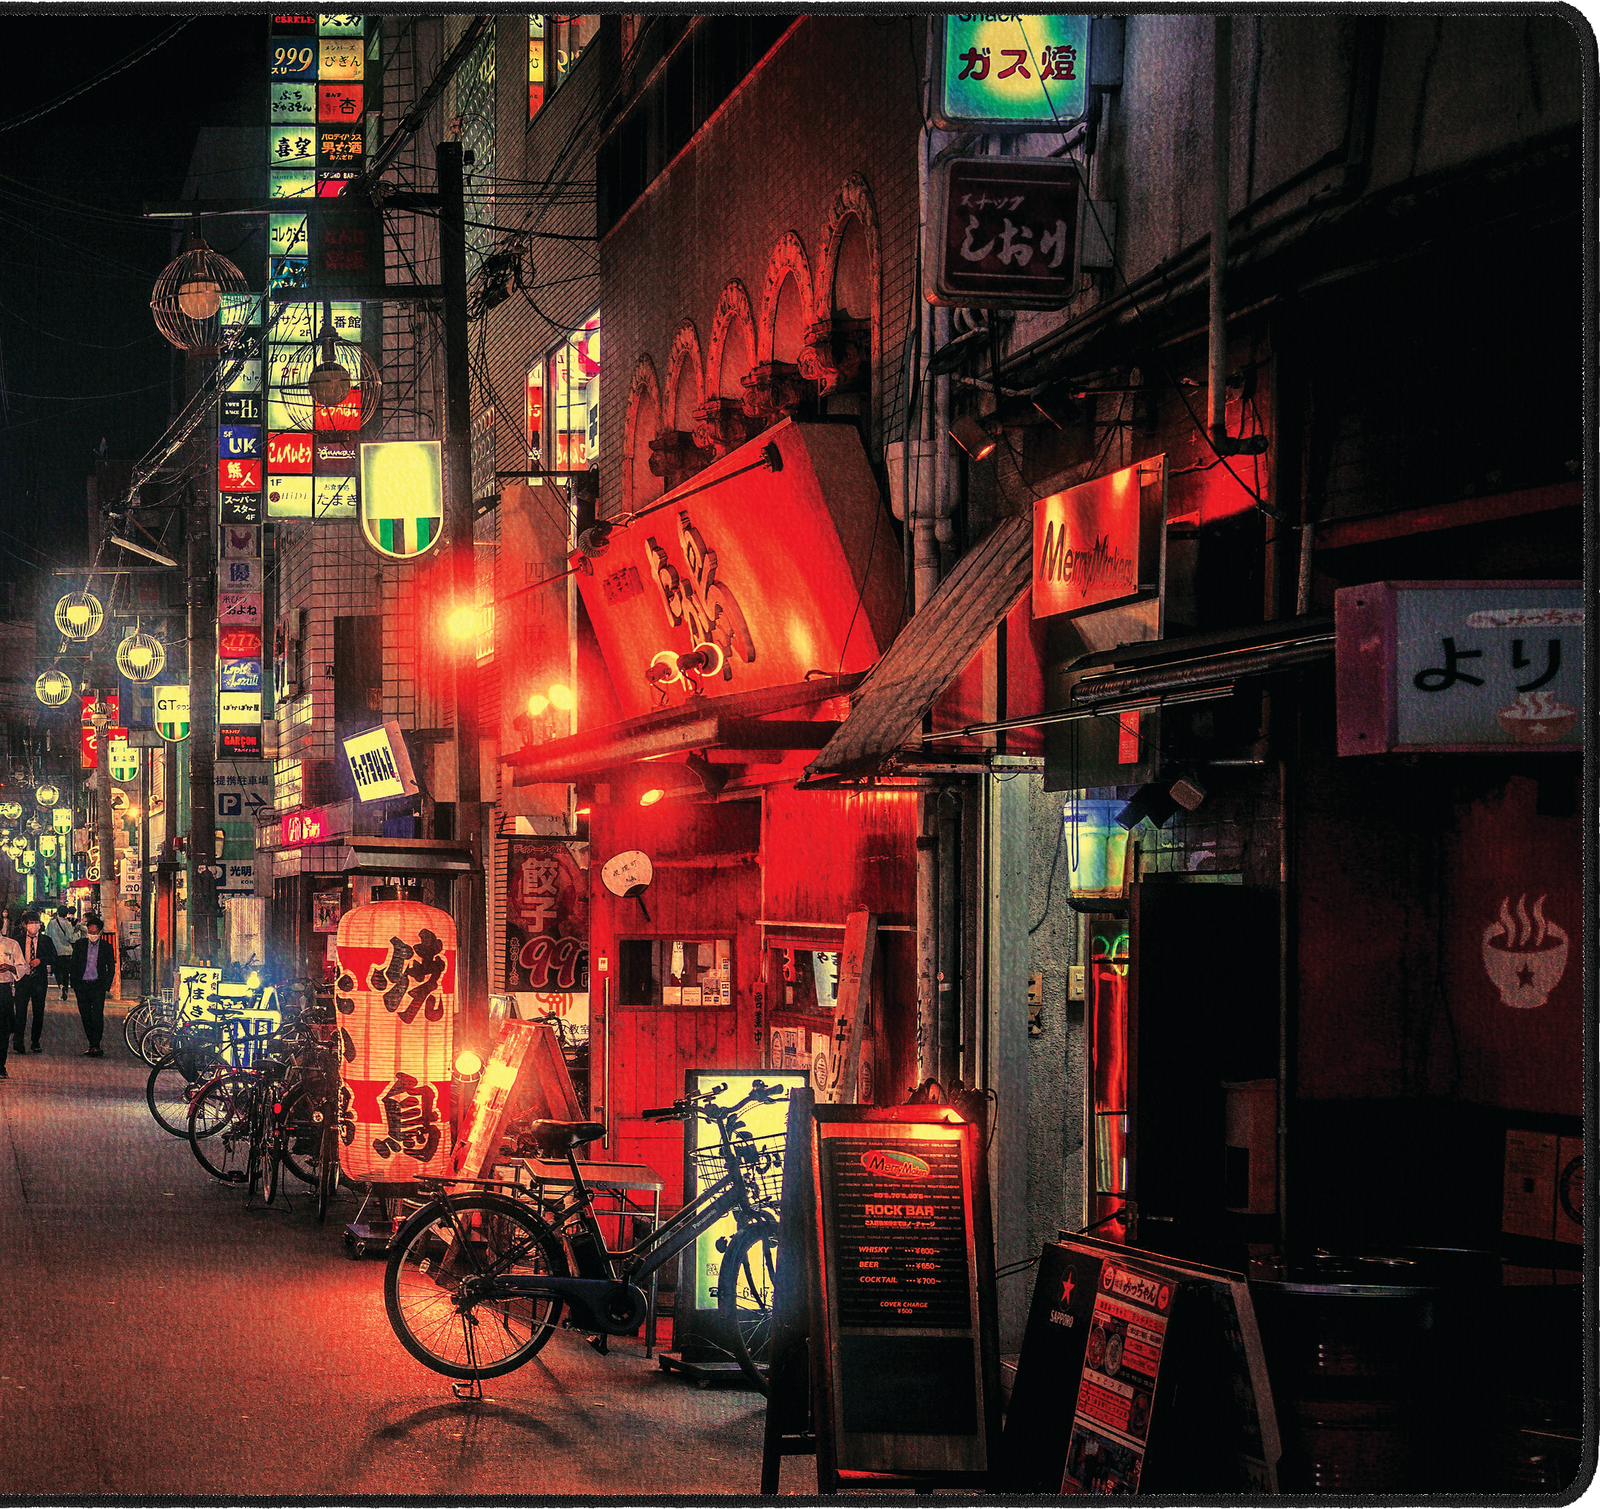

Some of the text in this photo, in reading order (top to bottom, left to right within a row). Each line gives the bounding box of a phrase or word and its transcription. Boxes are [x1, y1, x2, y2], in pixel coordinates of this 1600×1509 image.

[274, 48, 313, 71] 999
[325, 56, 361, 67] びぎん
[958, 44, 1078, 82] ガス燈
[339, 98, 356, 114] 杏
[275, 136, 311, 158] 喜望
[272, 227, 309, 242] コレクショ
[960, 213, 1068, 270] しおり
[300, 329, 312, 337] 2F
[281, 368, 299, 378] 2F
[240, 400, 258, 418] H2
[229, 438, 257, 453] UK
[268, 443, 311, 463] こんぺいとう
[227, 462, 256, 486] 熊人
[230, 563, 250, 582] 優
[226, 605, 257, 615] およね
[229, 634, 256, 646] 777
[1414, 637, 1561, 694] より
[224, 736, 257, 748] GARÇON
[230, 866, 254, 877] 光明
[521, 858, 560, 933] 餃子
[520, 936, 581, 988] 99
[368, 928, 448, 1162] 焼鳥
[692, 1208, 717, 1229] Panasonic
[865, 1204, 934, 1216] ROCK BAR
[1050, 1310, 1074, 1328] SAPPORO
